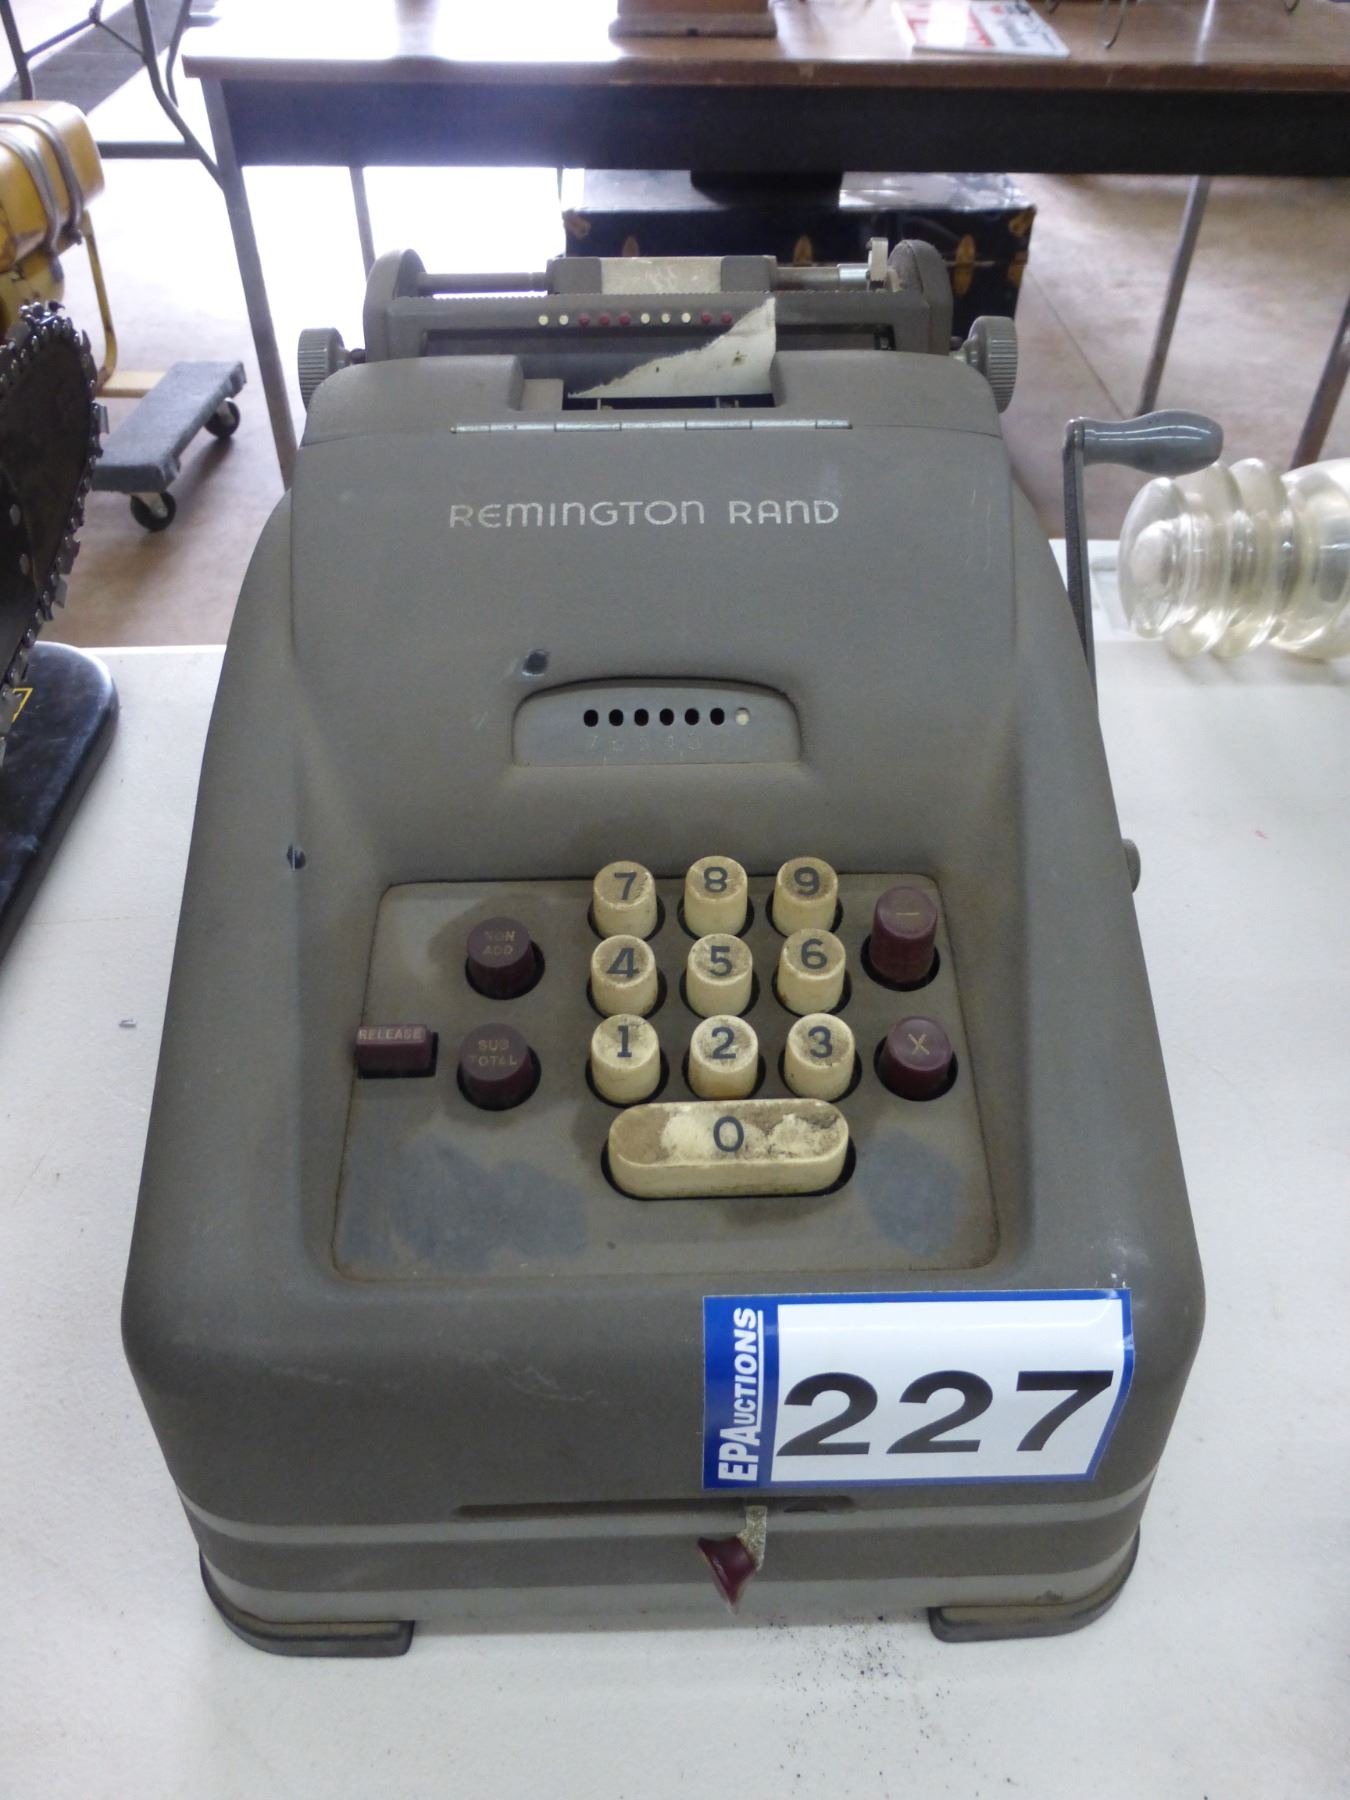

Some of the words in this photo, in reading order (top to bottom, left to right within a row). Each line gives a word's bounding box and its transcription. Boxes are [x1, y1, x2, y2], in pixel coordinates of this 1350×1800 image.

[449, 500, 705, 528] REMINGTON
[728, 499, 840, 525] RAND
[614, 871, 638, 900] 7
[703, 866, 729, 893] 8
[793, 866, 821, 896] 9
[606, 947, 640, 979] 4
[709, 945, 733, 977] 5
[800, 938, 828, 970] 6
[358, 1026, 424, 1041] RELEASE
[616, 1025, 633, 1059] 1
[710, 1026, 737, 1060] 2
[807, 1025, 834, 1059] 3
[712, 1115, 745, 1153] 0
[776, 1369, 1115, 1457] 227
